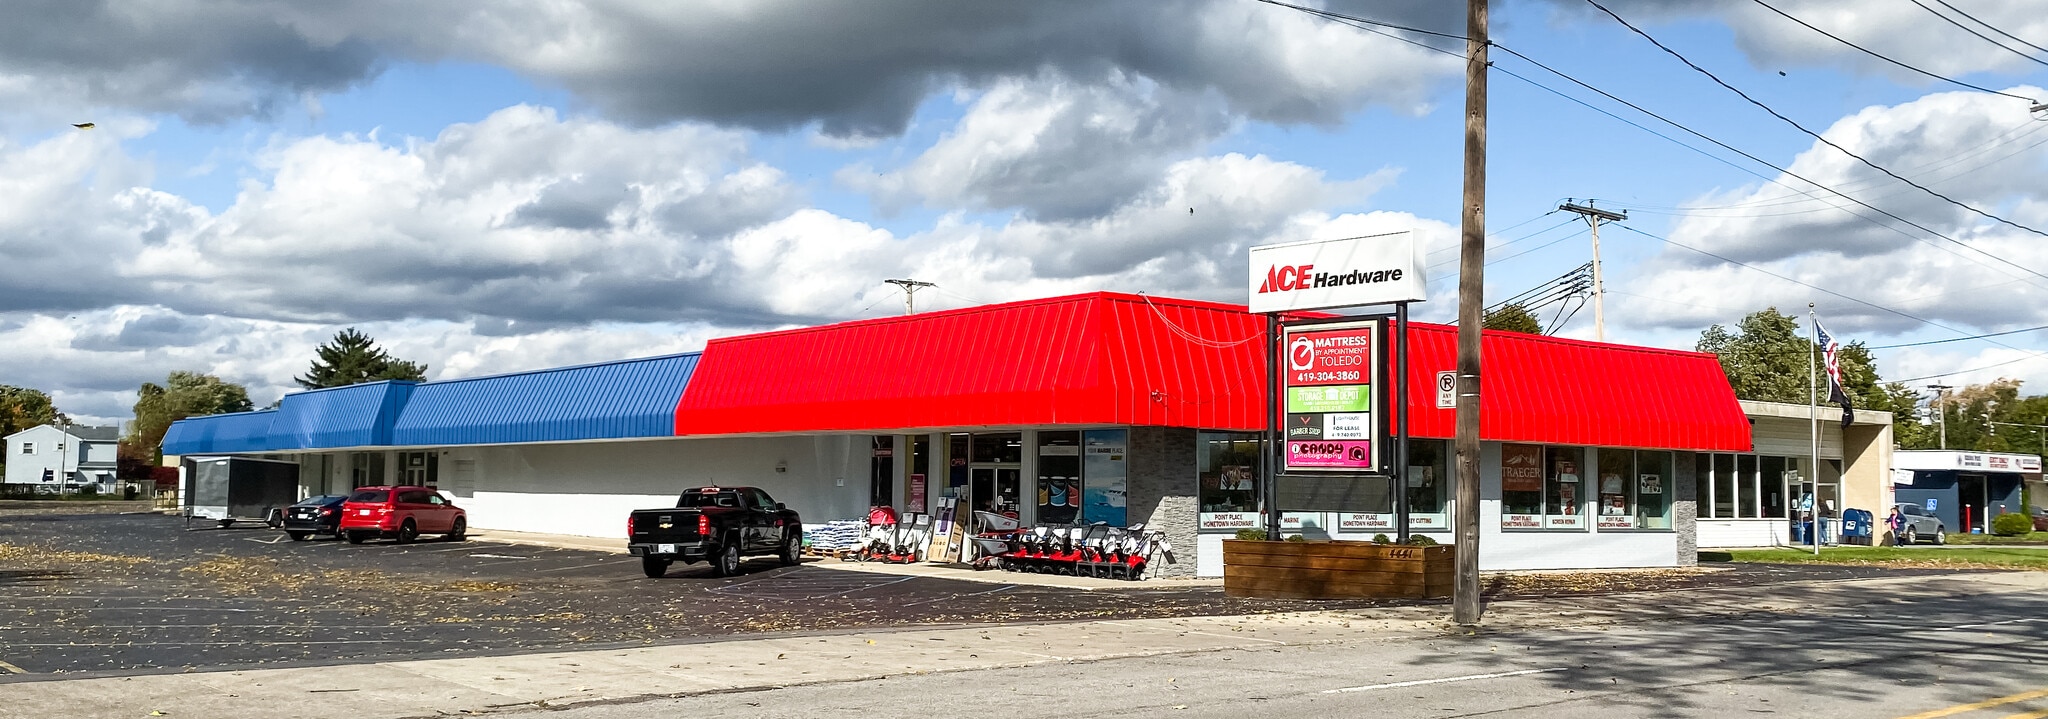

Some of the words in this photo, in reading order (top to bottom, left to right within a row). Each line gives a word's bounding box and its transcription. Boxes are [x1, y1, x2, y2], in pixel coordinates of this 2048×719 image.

[1258, 264, 1313, 293] ACE
[1314, 268, 1403, 288] Hardware
[1315, 336, 1367, 347] MATTRESS
[1324, 347, 1367, 355] APPOINTMENT
[1320, 355, 1362, 366] TOLEDO
[1298, 370, 1360, 382] 419-304-3860
[1297, 391, 1324, 401] STORAGE
[1339, 390, 1360, 401] DEPOT
[1290, 428, 1309, 436] BARBER
[1309, 427, 1321, 435] SHOP
[1294, 452, 1342, 460] photography
[1502, 467, 1542, 478] TRAEGER
[1389, 549, 1414, 559] 4441
